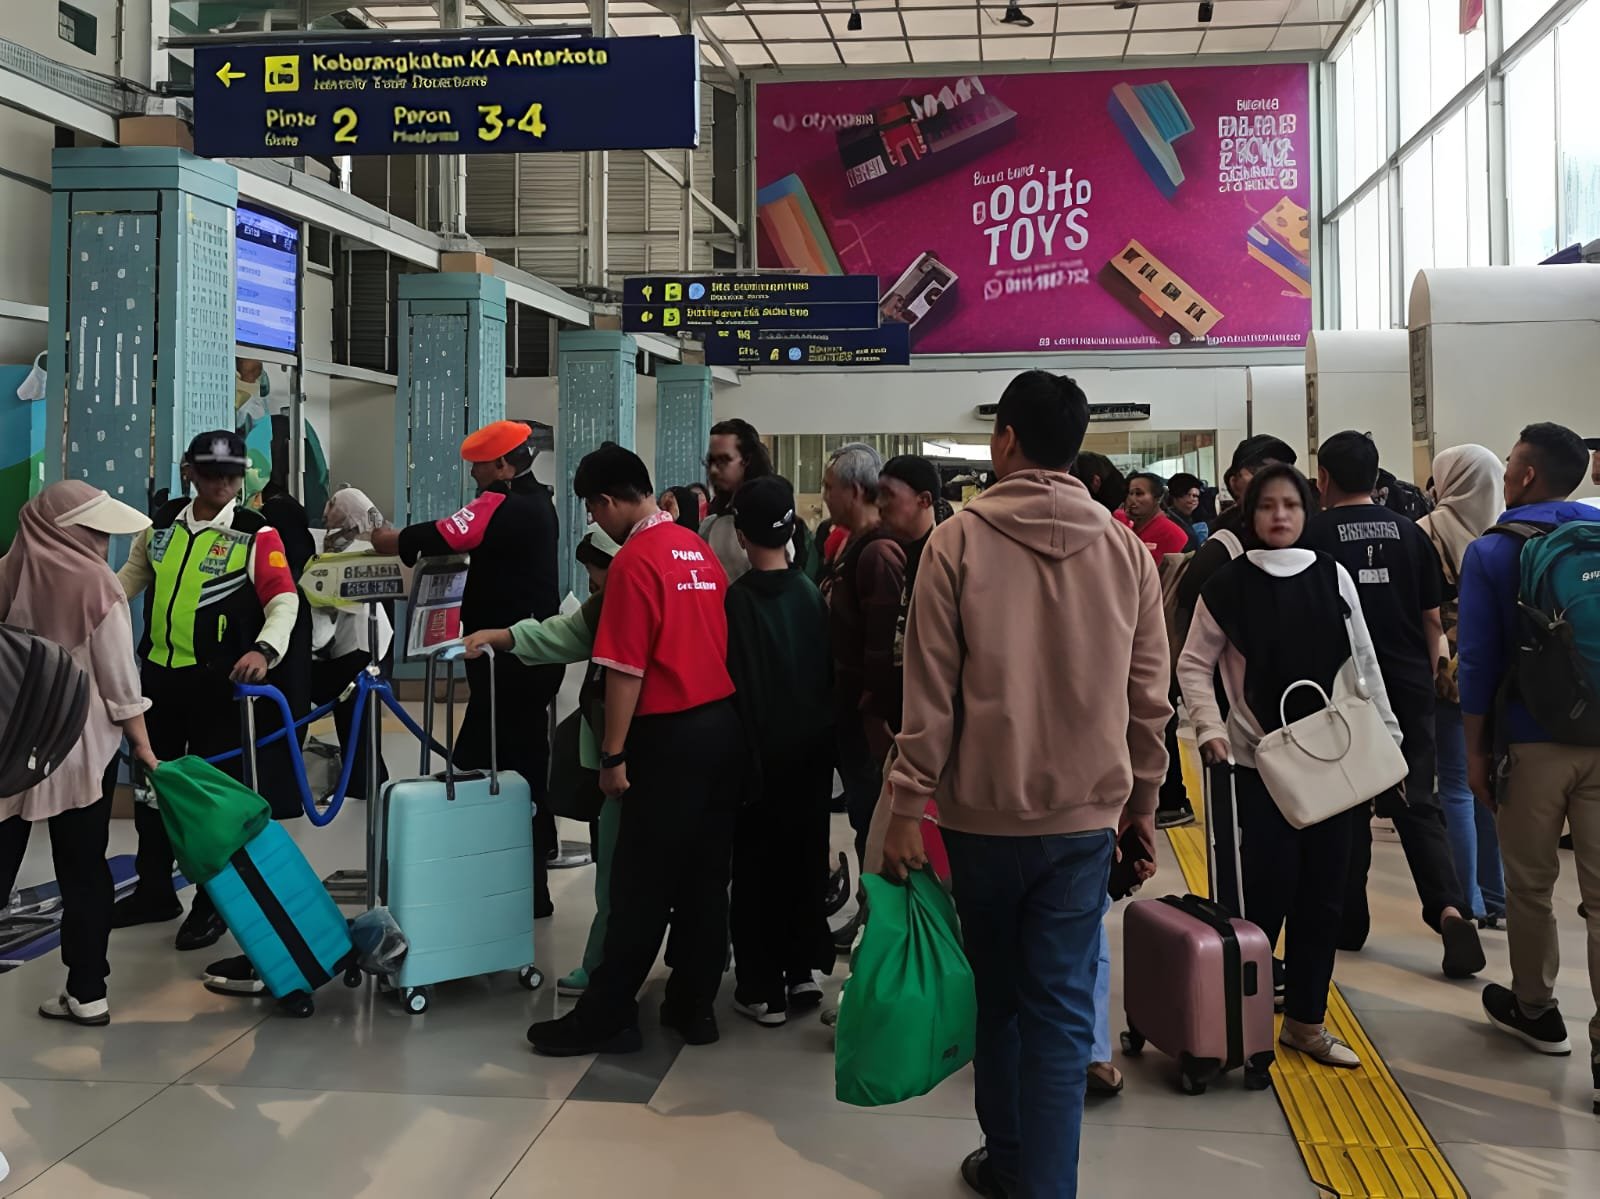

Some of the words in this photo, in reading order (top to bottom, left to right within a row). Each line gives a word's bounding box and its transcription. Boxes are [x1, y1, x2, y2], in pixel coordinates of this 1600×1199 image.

[469, 48, 501, 68] KA
[332, 106, 359, 144] 2
[983, 207, 1089, 266] TOYS
